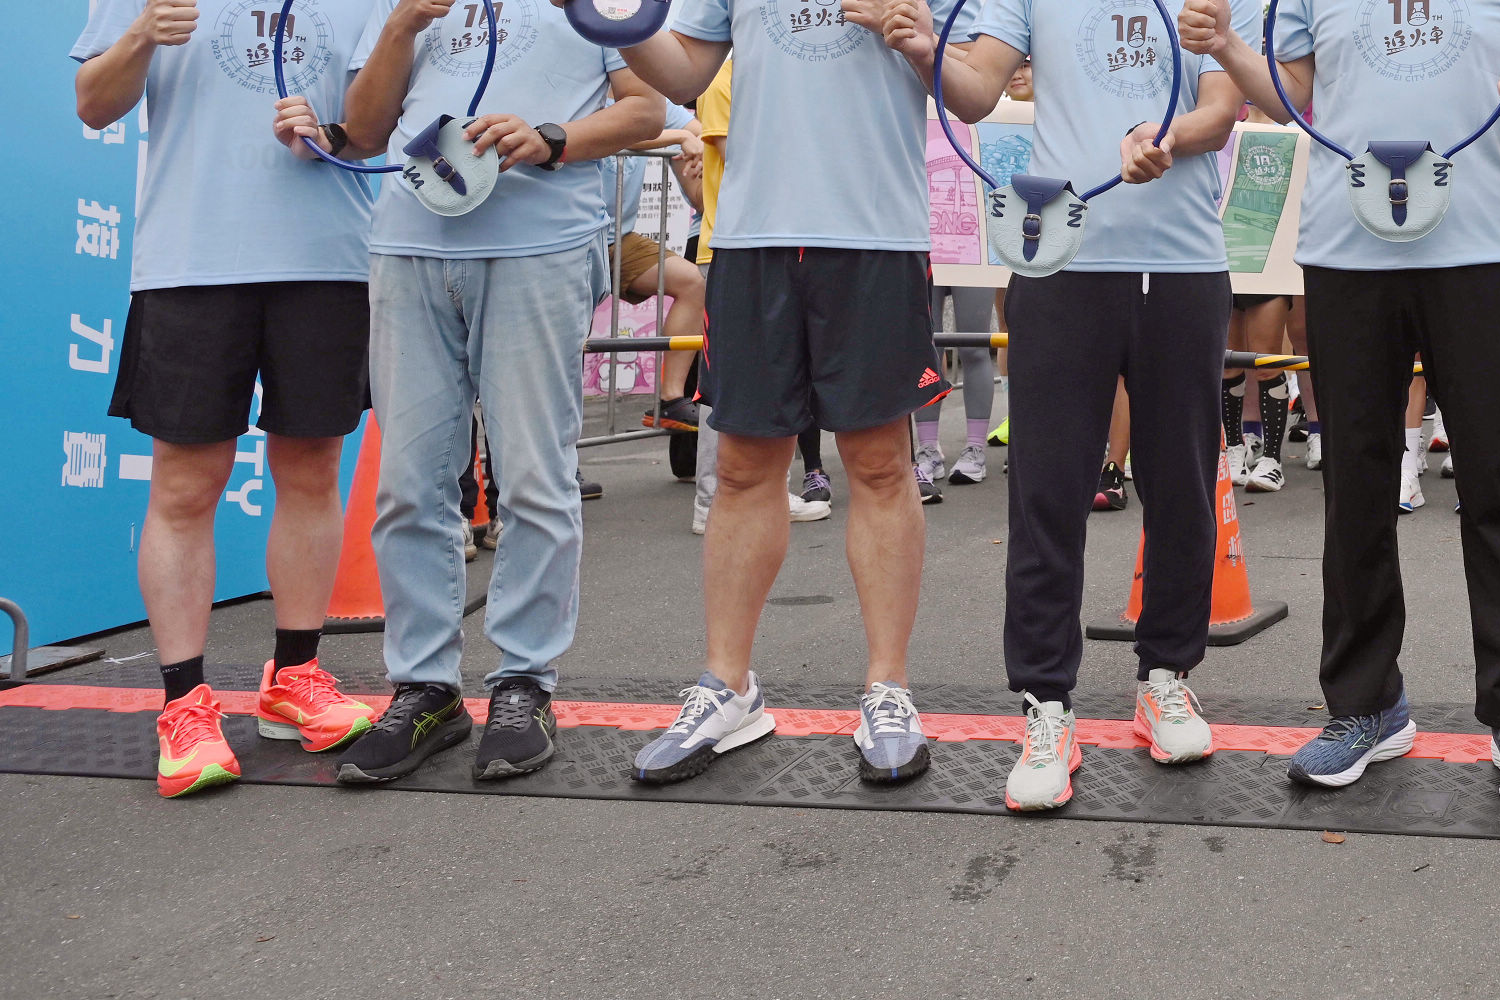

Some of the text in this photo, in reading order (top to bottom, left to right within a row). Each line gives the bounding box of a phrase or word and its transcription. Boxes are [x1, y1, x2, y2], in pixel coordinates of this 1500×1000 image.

[295, 35, 307, 43] TH
[522, 28, 540, 54] RELAY
[765, 26, 782, 45] NEW
[780, 43, 807, 62] TAIPEI
[808, 53, 828, 62] CITY
[830, 35, 865, 60] RAILWAY
[1111, 14, 1148, 48] 10
[1383, 26, 1444, 56] 追火車
[210, 39, 223, 60] 2025
[218, 60, 237, 79] NEW
[236, 77, 266, 94] TAIPEI
[1106, 46, 1156, 73] 追火車
[1352, 25, 1473, 83] 2025 NEW TAIPEI CITY RAILWAY RELAY
[1098, 80, 1125, 99] TAIPEI
[1127, 91, 1145, 100] CITY
